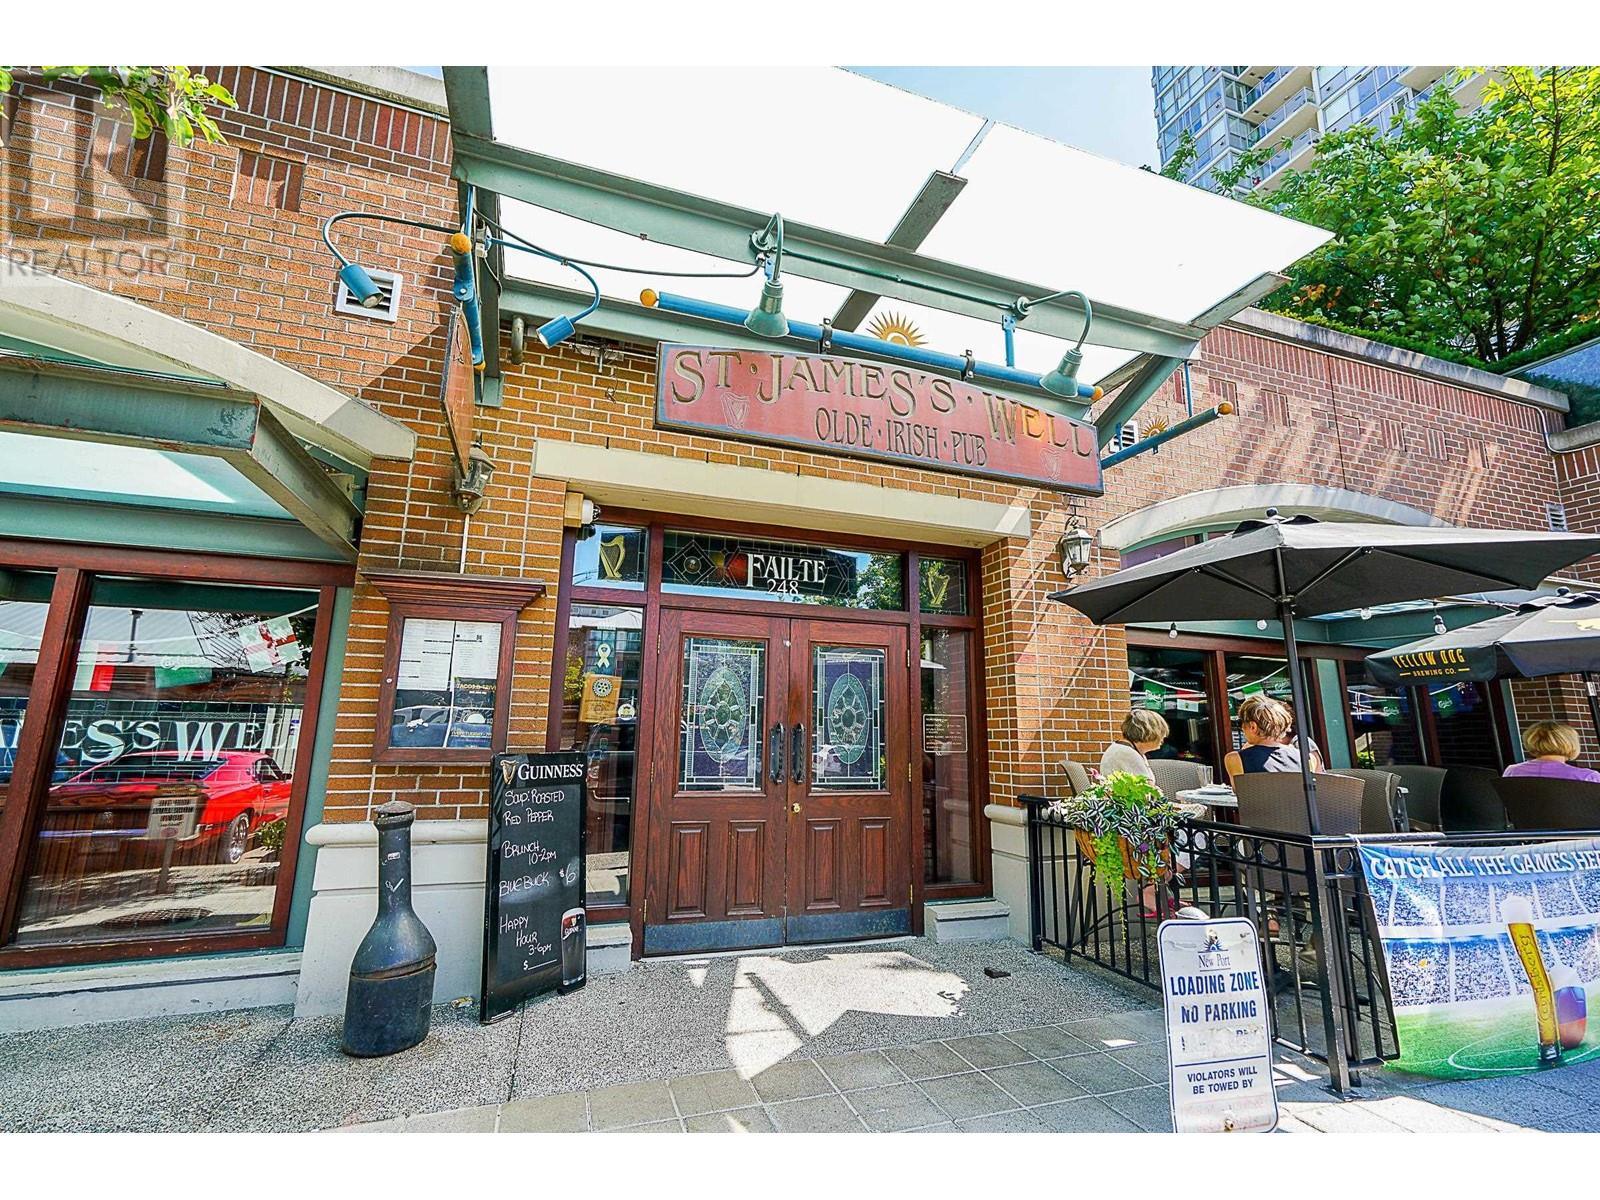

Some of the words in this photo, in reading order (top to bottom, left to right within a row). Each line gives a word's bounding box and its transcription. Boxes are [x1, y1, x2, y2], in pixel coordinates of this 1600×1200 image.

[756, 354, 957, 417] JAMES'S
[982, 391, 1092, 458] WELL
[815, 407, 873, 448] OLDE
[885, 419, 940, 460] IRISH
[950, 431, 988, 467] PUB
[746, 553, 826, 587] FAILTE
[767, 578, 799, 595] 248
[1392, 651, 1436, 668] YELLOW
[1440, 649, 1465, 664] DOG
[1413, 669, 1442, 677] BREWING
[1445, 667, 1456, 675] CO.
[517, 763, 584, 780] GUINNESS
[526, 807, 554, 823] PEPPER
[501, 840, 540, 858] BRUNCH
[1371, 857, 1438, 879] CATCH
[1437, 855, 1474, 877] ALL
[1471, 854, 1512, 876] THE
[1510, 851, 1575, 874] GAMES
[499, 913, 528, 935] HAPPY
[1170, 974, 1225, 996] LOADING
[1230, 971, 1260, 992] ZONE
[1181, 1004, 1199, 1024] NO
[1205, 1000, 1257, 1022] PARKING
[1187, 1068, 1235, 1082] VIOLATORS
[1238, 1066, 1257, 1076] WILL
[1193, 1085, 1205, 1094] BE
[1208, 1081, 1239, 1093] TOWED
[1243, 1079, 1254, 1088] BY
